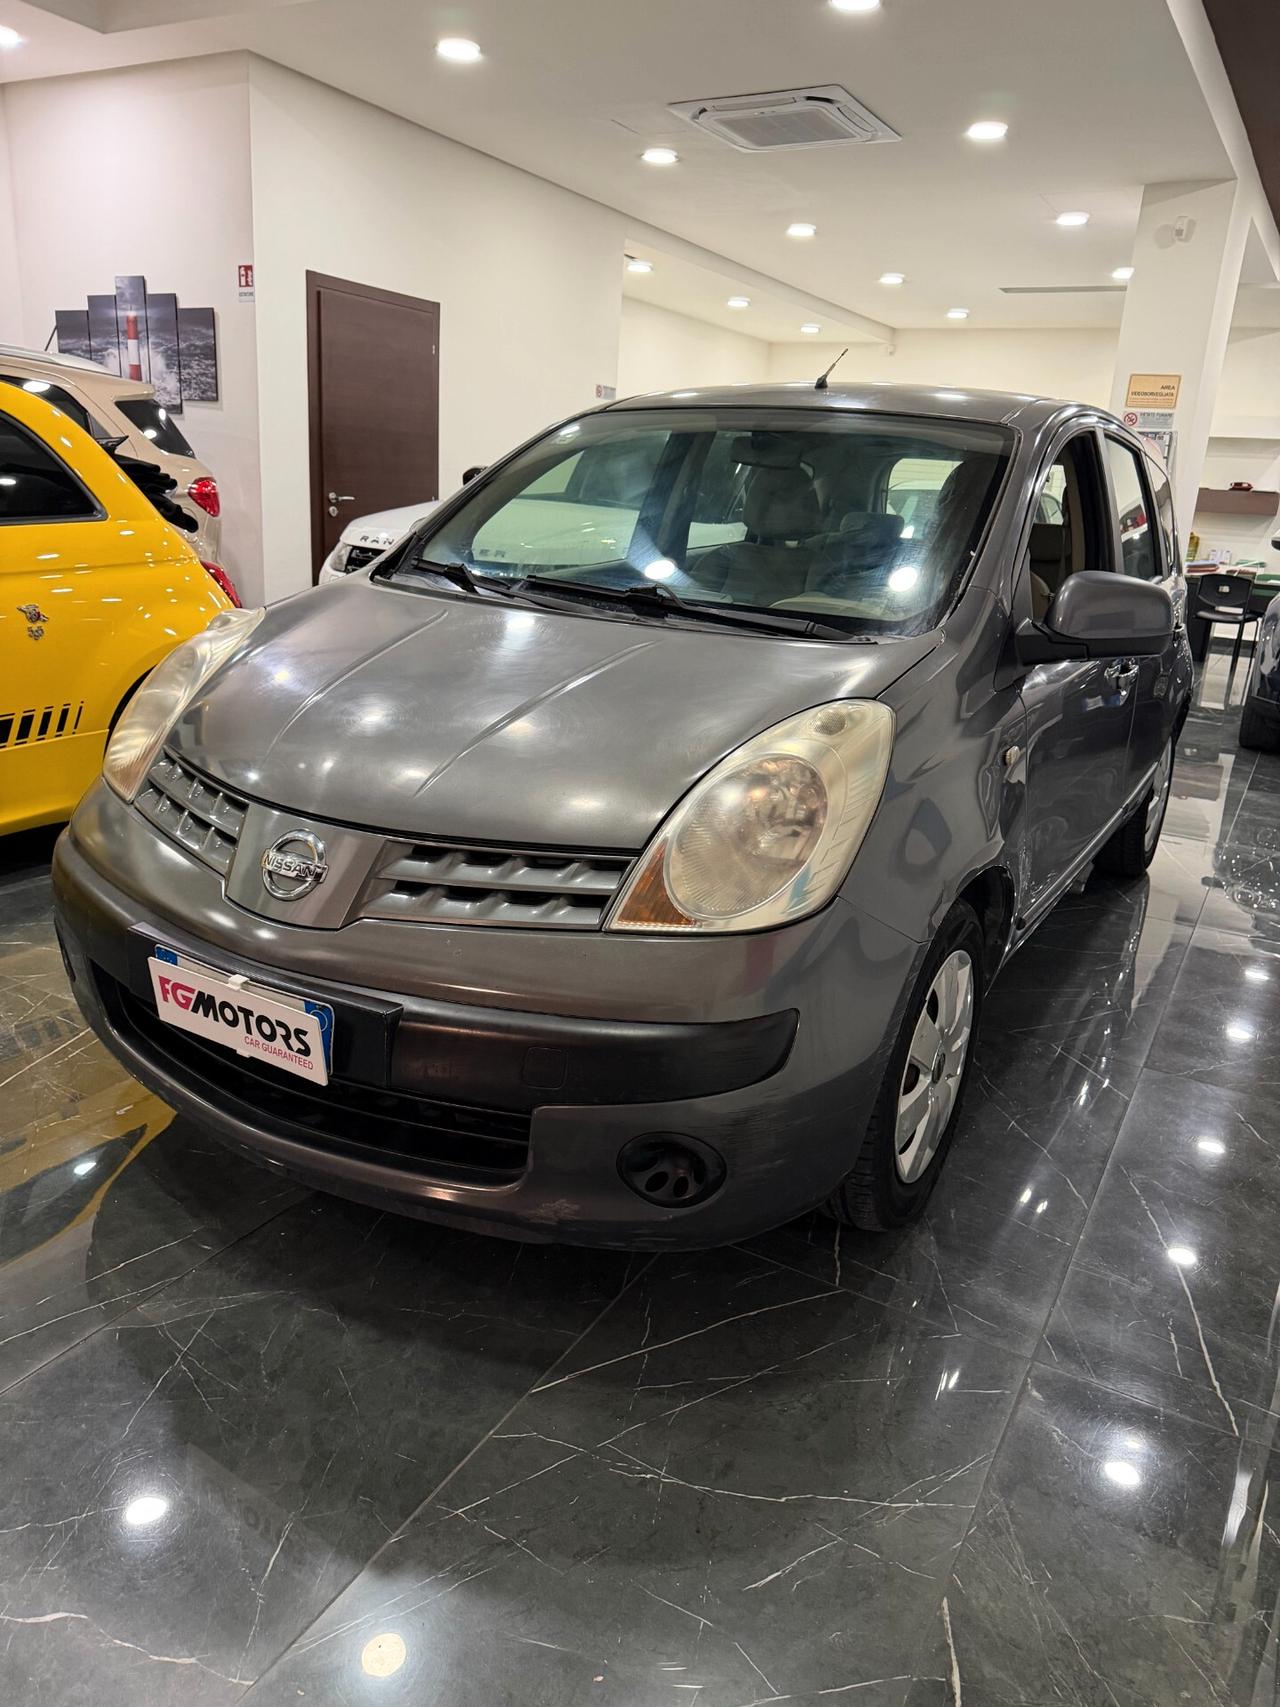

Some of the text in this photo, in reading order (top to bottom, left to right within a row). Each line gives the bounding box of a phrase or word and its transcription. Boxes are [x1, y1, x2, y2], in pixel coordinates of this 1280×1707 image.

[360, 535, 395, 545] RAN
[263, 854, 316, 877] NISSAN
[244, 1035, 314, 1070] CAR GUARANTEED
